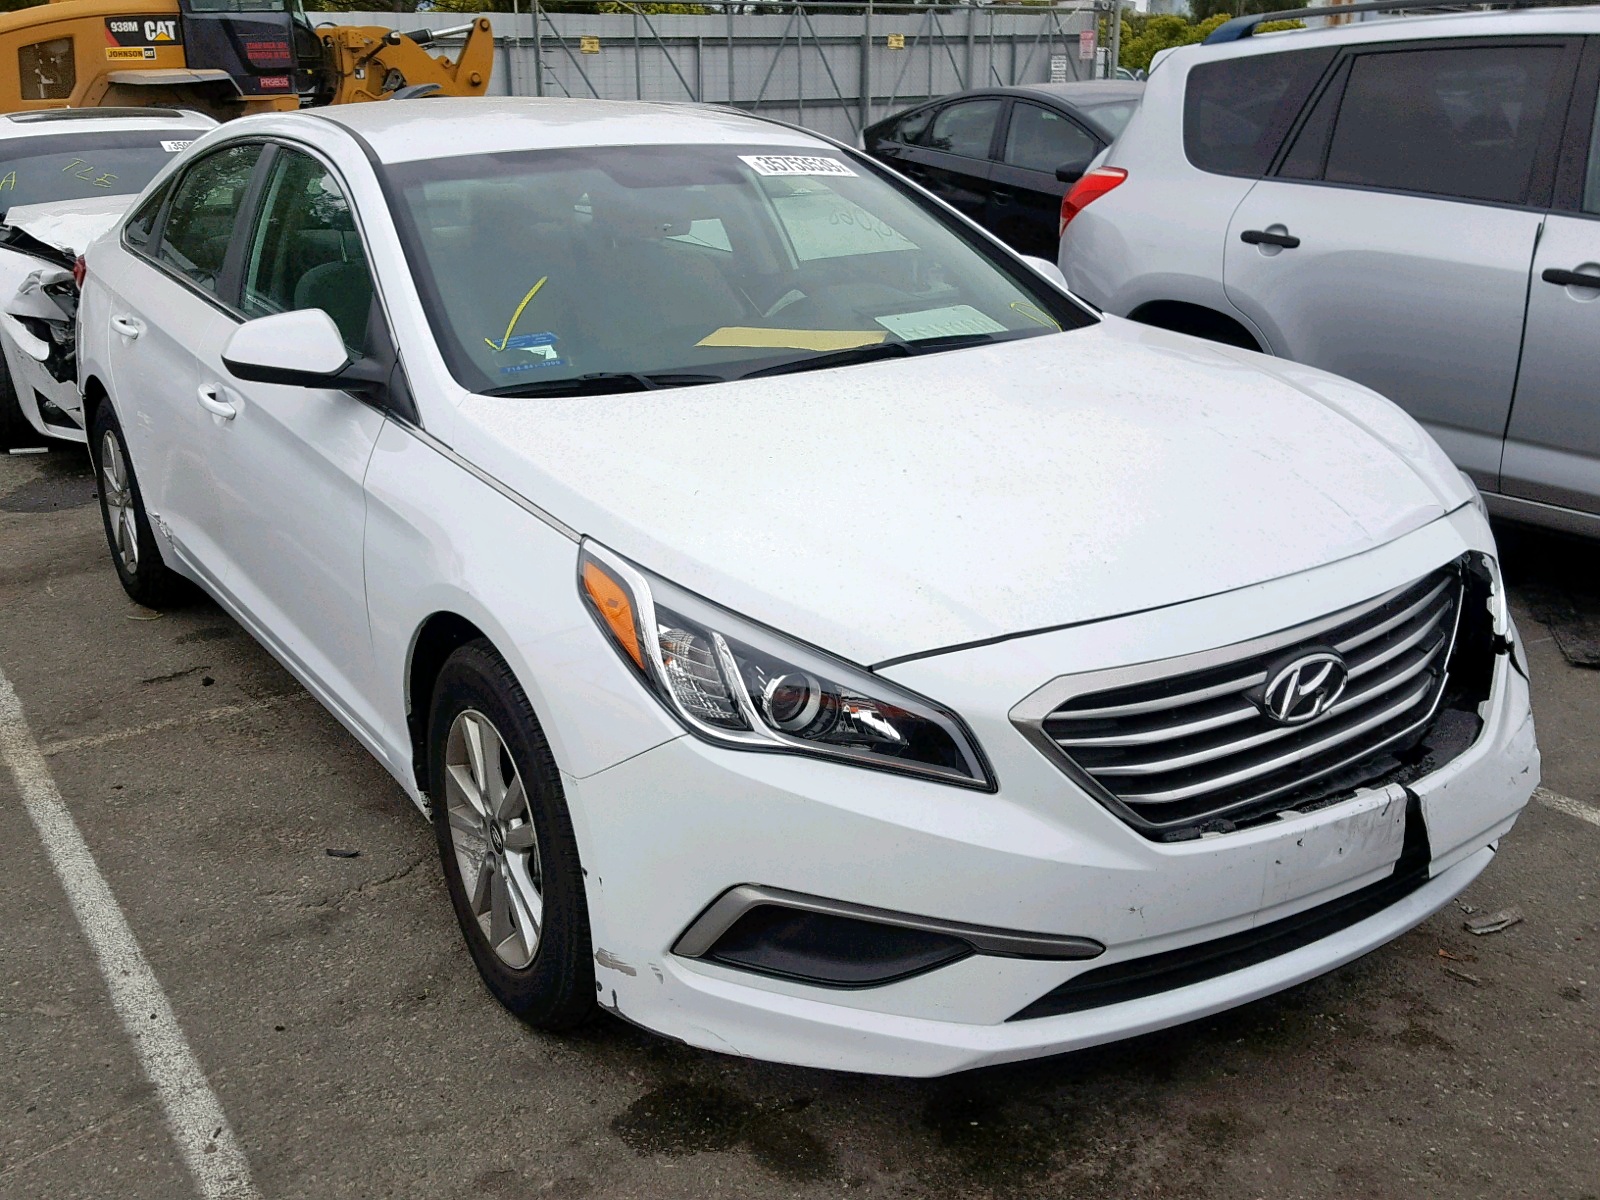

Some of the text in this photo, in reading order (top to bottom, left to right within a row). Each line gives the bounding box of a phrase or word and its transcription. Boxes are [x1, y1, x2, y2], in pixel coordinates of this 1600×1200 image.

[110, 21, 139, 32] 938M
[143, 20, 176, 41] CAT
[108, 50, 143, 58] JOHNSON
